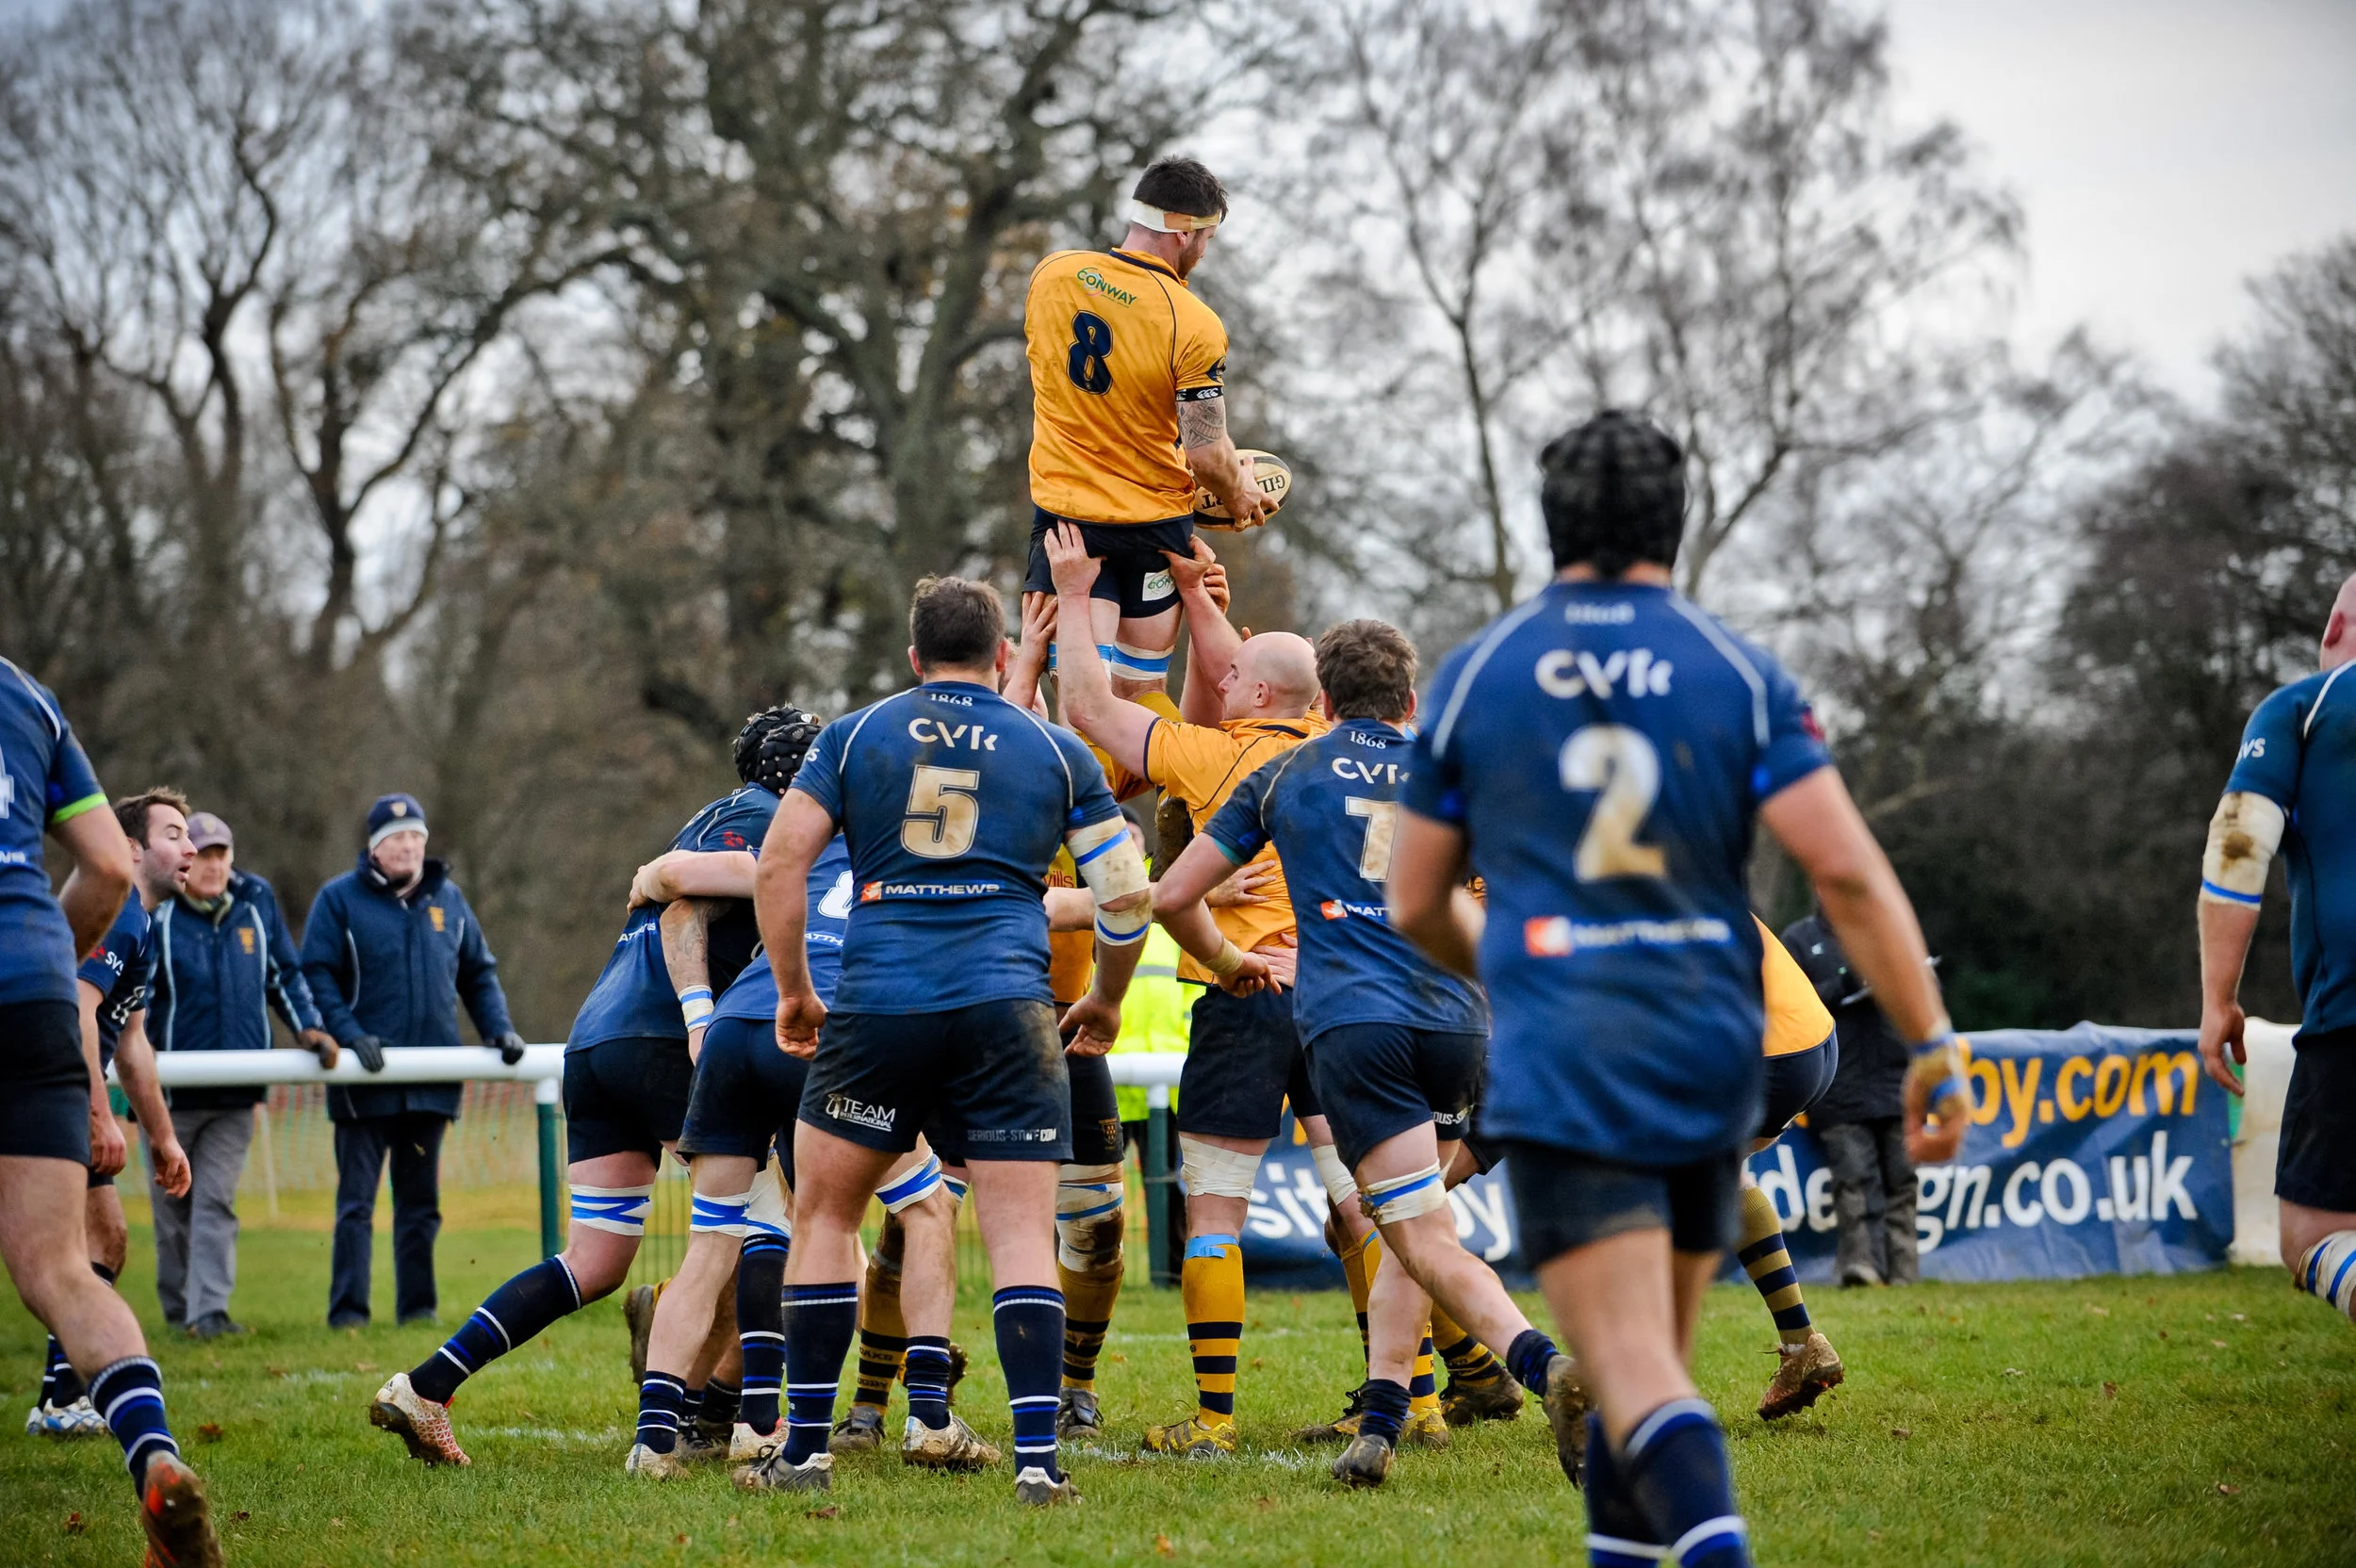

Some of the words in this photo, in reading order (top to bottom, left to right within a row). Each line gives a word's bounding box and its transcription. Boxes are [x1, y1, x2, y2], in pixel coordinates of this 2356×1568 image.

[1077, 268, 1137, 305] CONWAY
[1066, 309, 1114, 396] 8
[930, 694, 973, 707] 1868
[1350, 730, 1387, 750] 1868
[900, 763, 980, 859] 5
[1558, 723, 1666, 884] 2
[1345, 795, 1399, 883] 7
[885, 884, 1001, 895] MATTHEWS
[843, 1097, 896, 1123] TEAM
